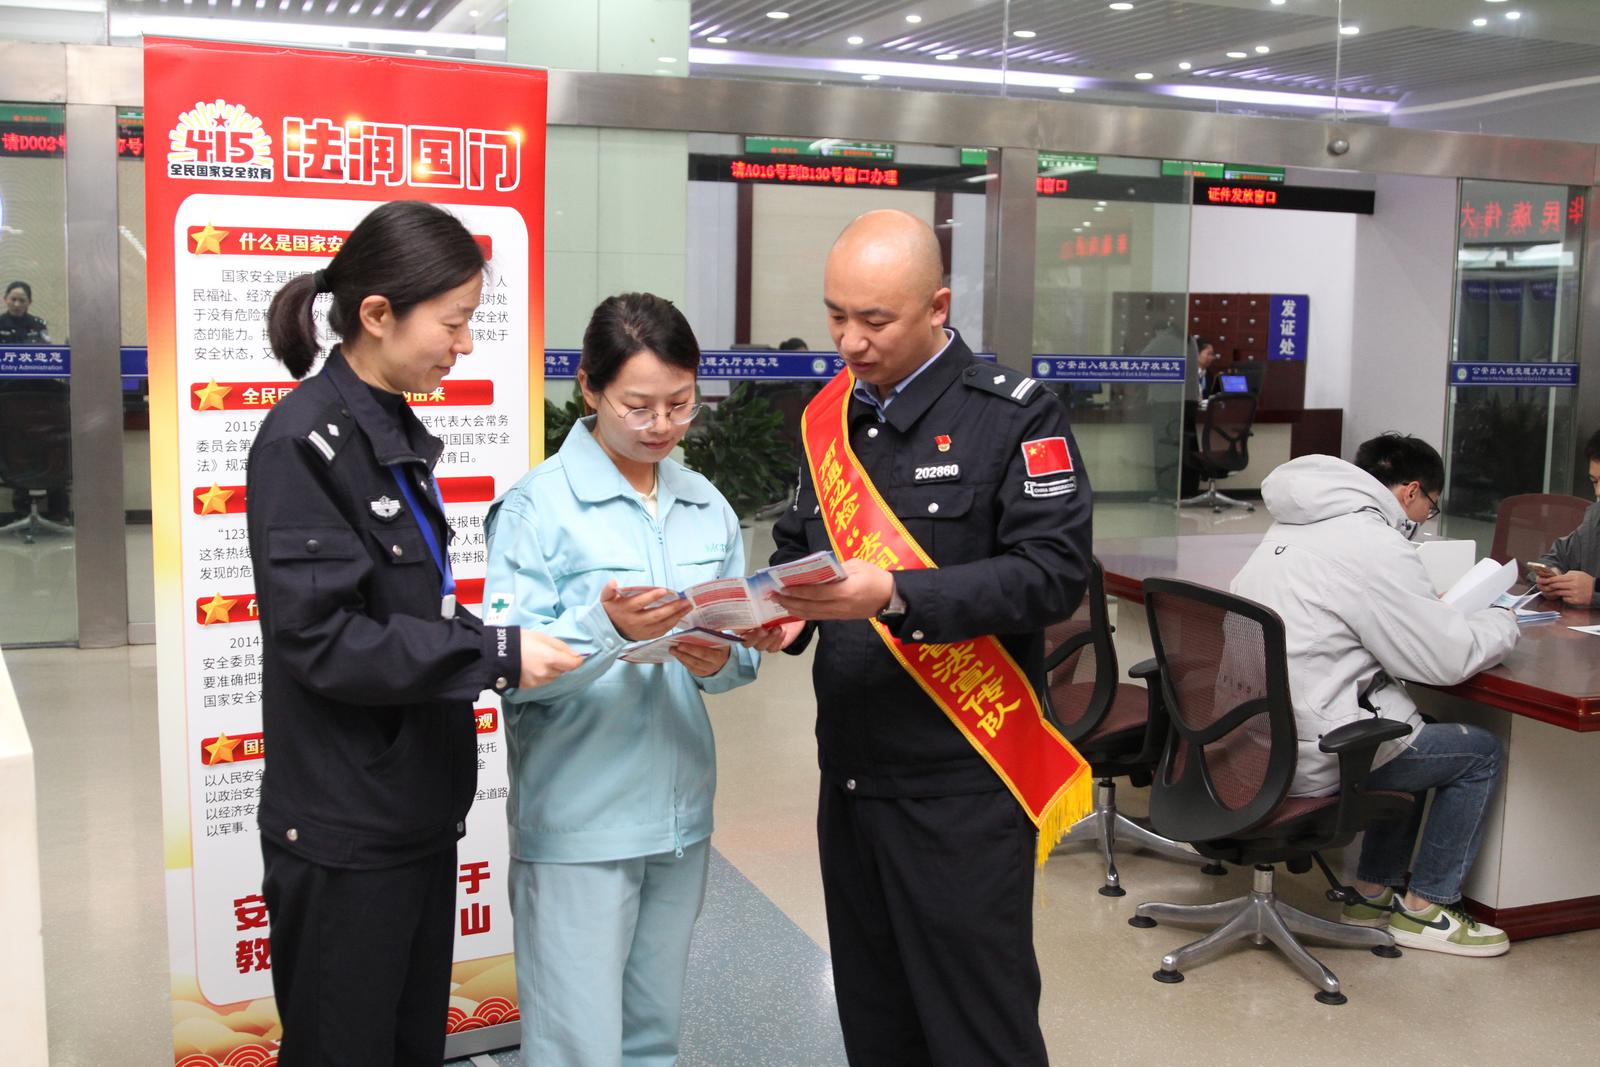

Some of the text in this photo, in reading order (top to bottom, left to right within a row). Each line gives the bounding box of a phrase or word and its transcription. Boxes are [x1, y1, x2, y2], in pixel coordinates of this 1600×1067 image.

[184, 129, 255, 164] 415
[283, 117, 523, 192] 法润国门
[170, 164, 273, 180] 全民国家安全教育
[1207, 186, 1277, 204] 证件发放窗口
[239, 232, 343, 252] 什么是国家安
[193, 289, 277, 302] 民福祉、经济
[469, 311, 509, 323] 安全状
[1279, 299, 1297, 355] 发证处
[0, 352, 63, 362] 厅欢迎您
[699, 357, 779, 367] 理大厅欢迎您
[421, 414, 509, 428] 民代表大会常务
[915, 464, 959, 480] 202860
[218, 516, 485, 540] “123 举报电
[200, 565, 252, 580] 发现的危
[230, 636, 263, 649] 2014
[497, 628, 507, 657] POLICE
[206, 803, 259, 821] 以经济安
[207, 822, 260, 837] 以军事、
[234, 861, 490, 931] 安 于
[236, 903, 490, 974] 教 山
